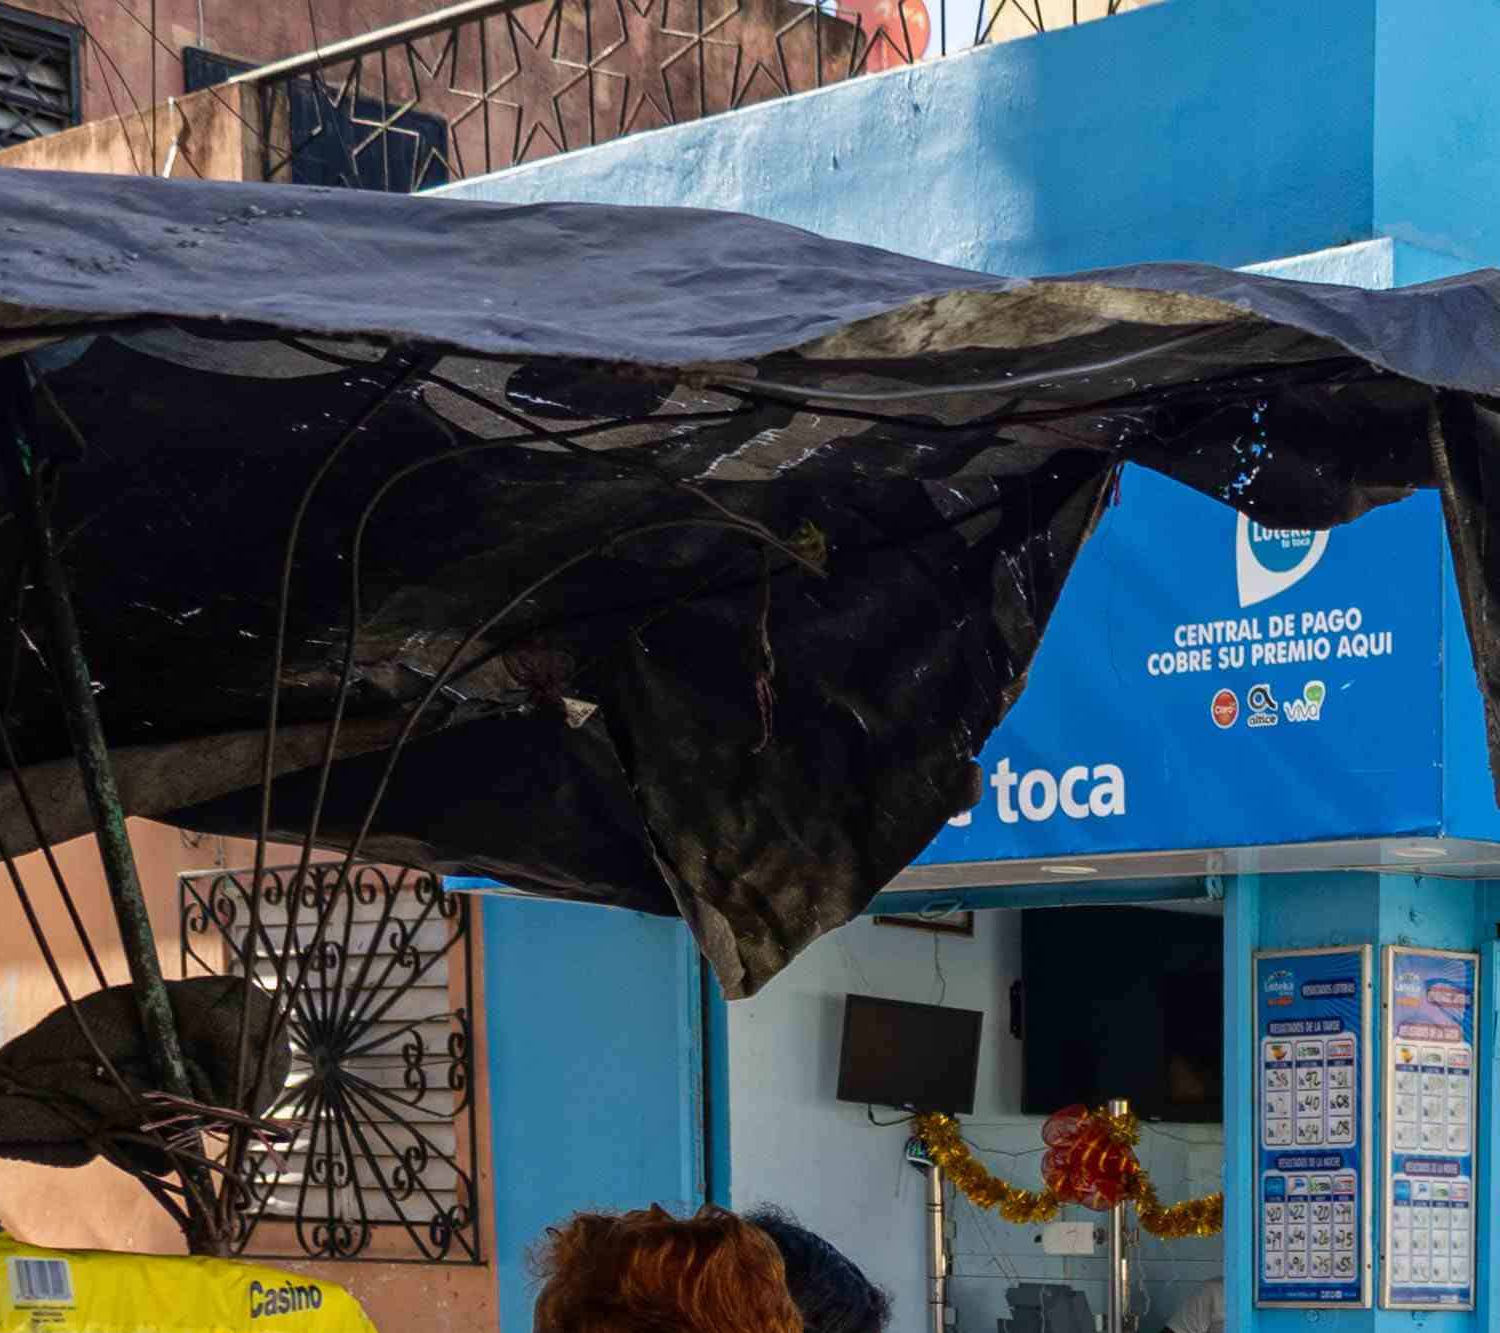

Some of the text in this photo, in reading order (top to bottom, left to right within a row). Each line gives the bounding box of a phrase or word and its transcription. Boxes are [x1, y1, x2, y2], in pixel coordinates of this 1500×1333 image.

[1174, 607, 1362, 648] CENTRAL DE PAGO
[1147, 631, 1393, 677] COBRE SU PREMIO AQUI
[990, 757, 1126, 824] toca
[250, 1280, 323, 1319] Casino
